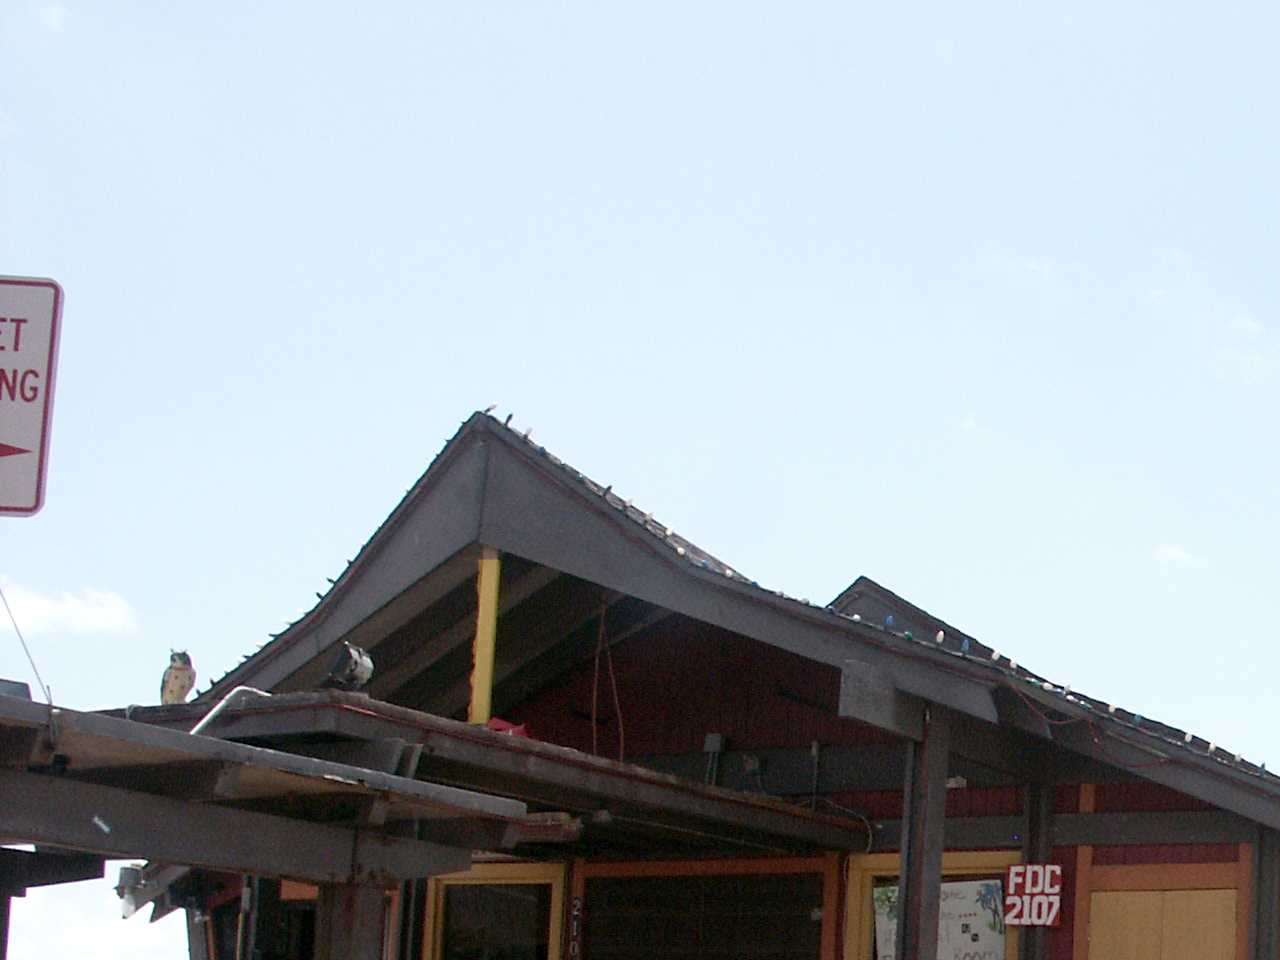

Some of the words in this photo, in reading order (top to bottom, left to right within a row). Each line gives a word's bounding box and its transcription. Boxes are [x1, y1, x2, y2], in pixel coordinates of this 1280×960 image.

[0, 369, 39, 402] NG
[1008, 864, 1062, 895] FDC
[1005, 895, 1061, 925] 2107
